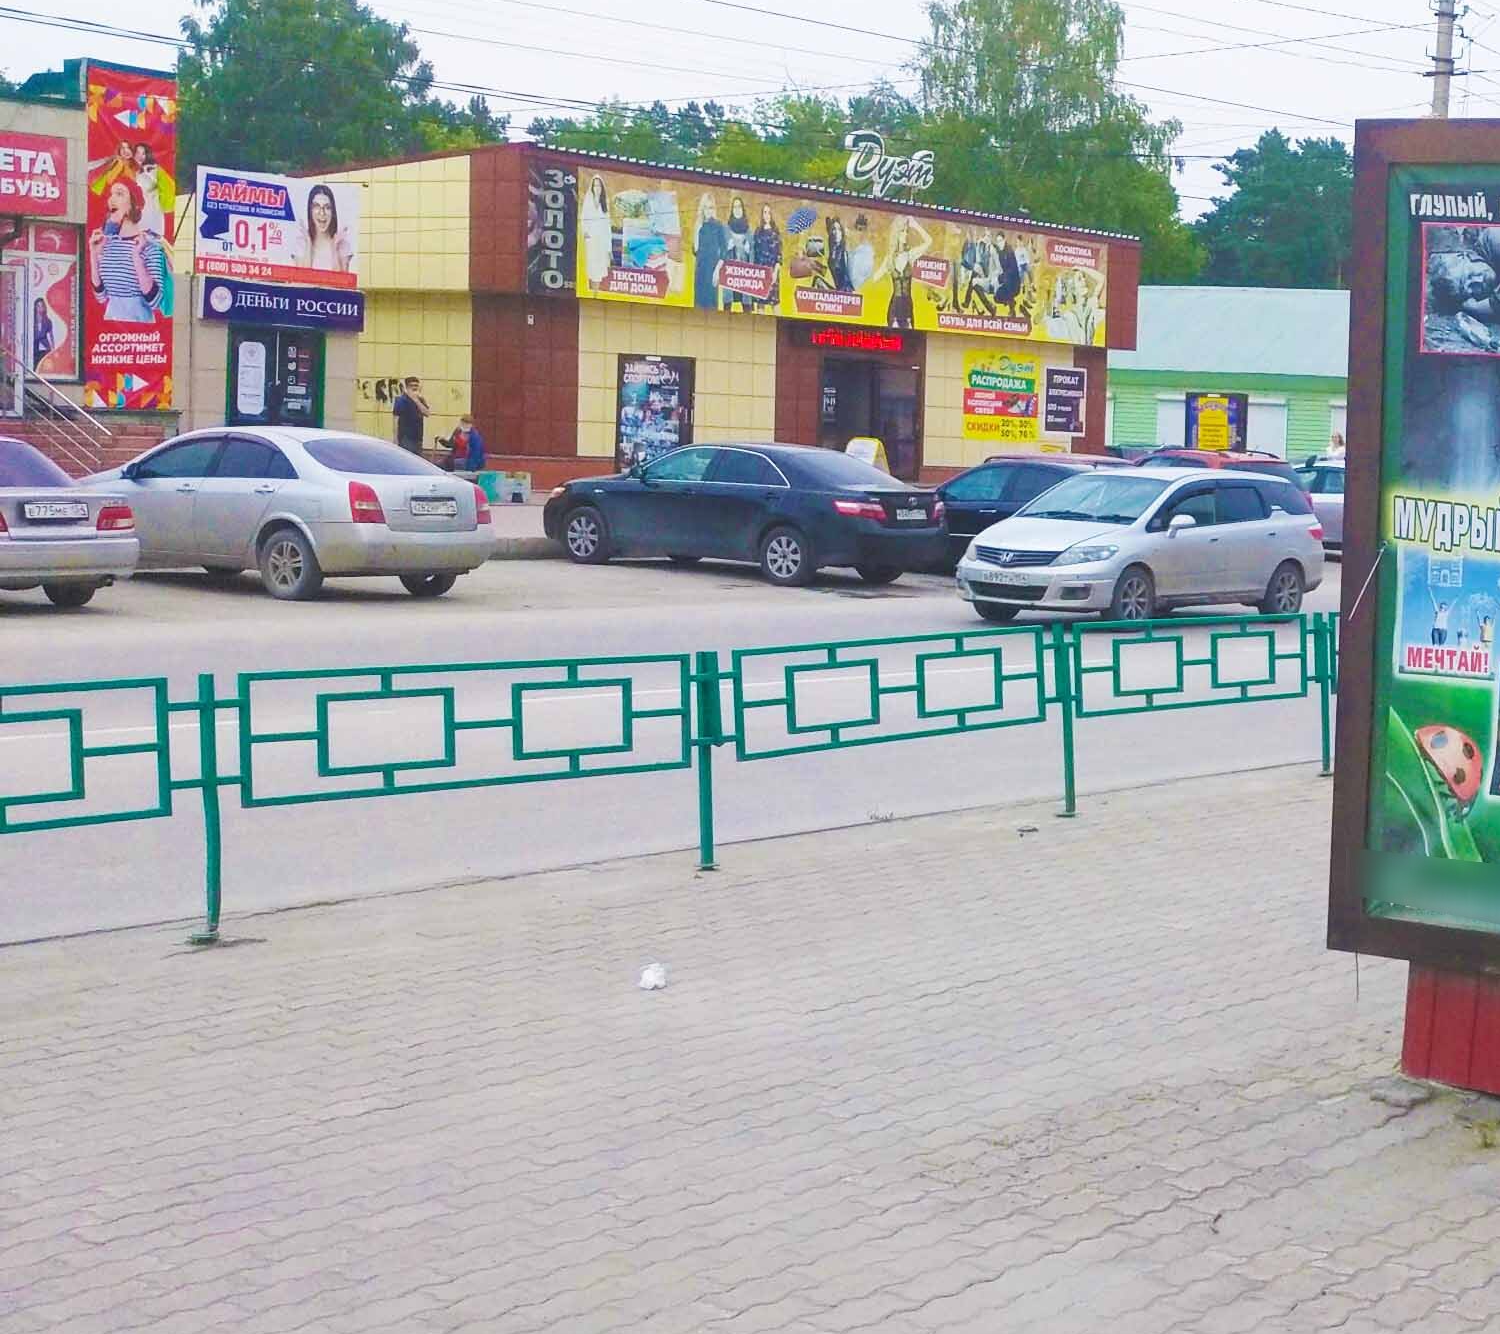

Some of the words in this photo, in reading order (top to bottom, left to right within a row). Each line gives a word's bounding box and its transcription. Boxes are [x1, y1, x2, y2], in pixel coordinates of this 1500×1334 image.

[845, 130, 934, 196] Дуэт
[207, 180, 286, 207] ЗАЙМЫ
[1409, 192, 1493, 221] ГЛУПЫЙ,
[612, 270, 656, 284] ТЕКСТИЛЬ
[726, 266, 766, 279] ЖЕНСКАЯ
[609, 281, 629, 292] ДЛЯ
[630, 282, 658, 294] ДОМА
[727, 277, 764, 290] ОДЕЖДА
[235, 293, 290, 310] ДЕНЬГИ
[296, 299, 359, 316] РОССИИ
[815, 302, 843, 313] СУМКИ
[939, 316, 965, 327] ОБУВЬ
[966, 318, 982, 329] ДЛЯ
[983, 319, 1003, 330] ВСЕЙ
[1004, 322, 1028, 333] СЕМЬИ
[99, 330, 160, 342] ОГРОМНЫЙ
[91, 353, 133, 364] НИЗКИЕ
[135, 355, 167, 365] ЦЕНЫ
[971, 375, 1027, 389] РАСПРОДАЖА
[1053, 375, 1080, 385] ПРОКАТ
[1406, 643, 1490, 674] МЕЧТАЙ!
